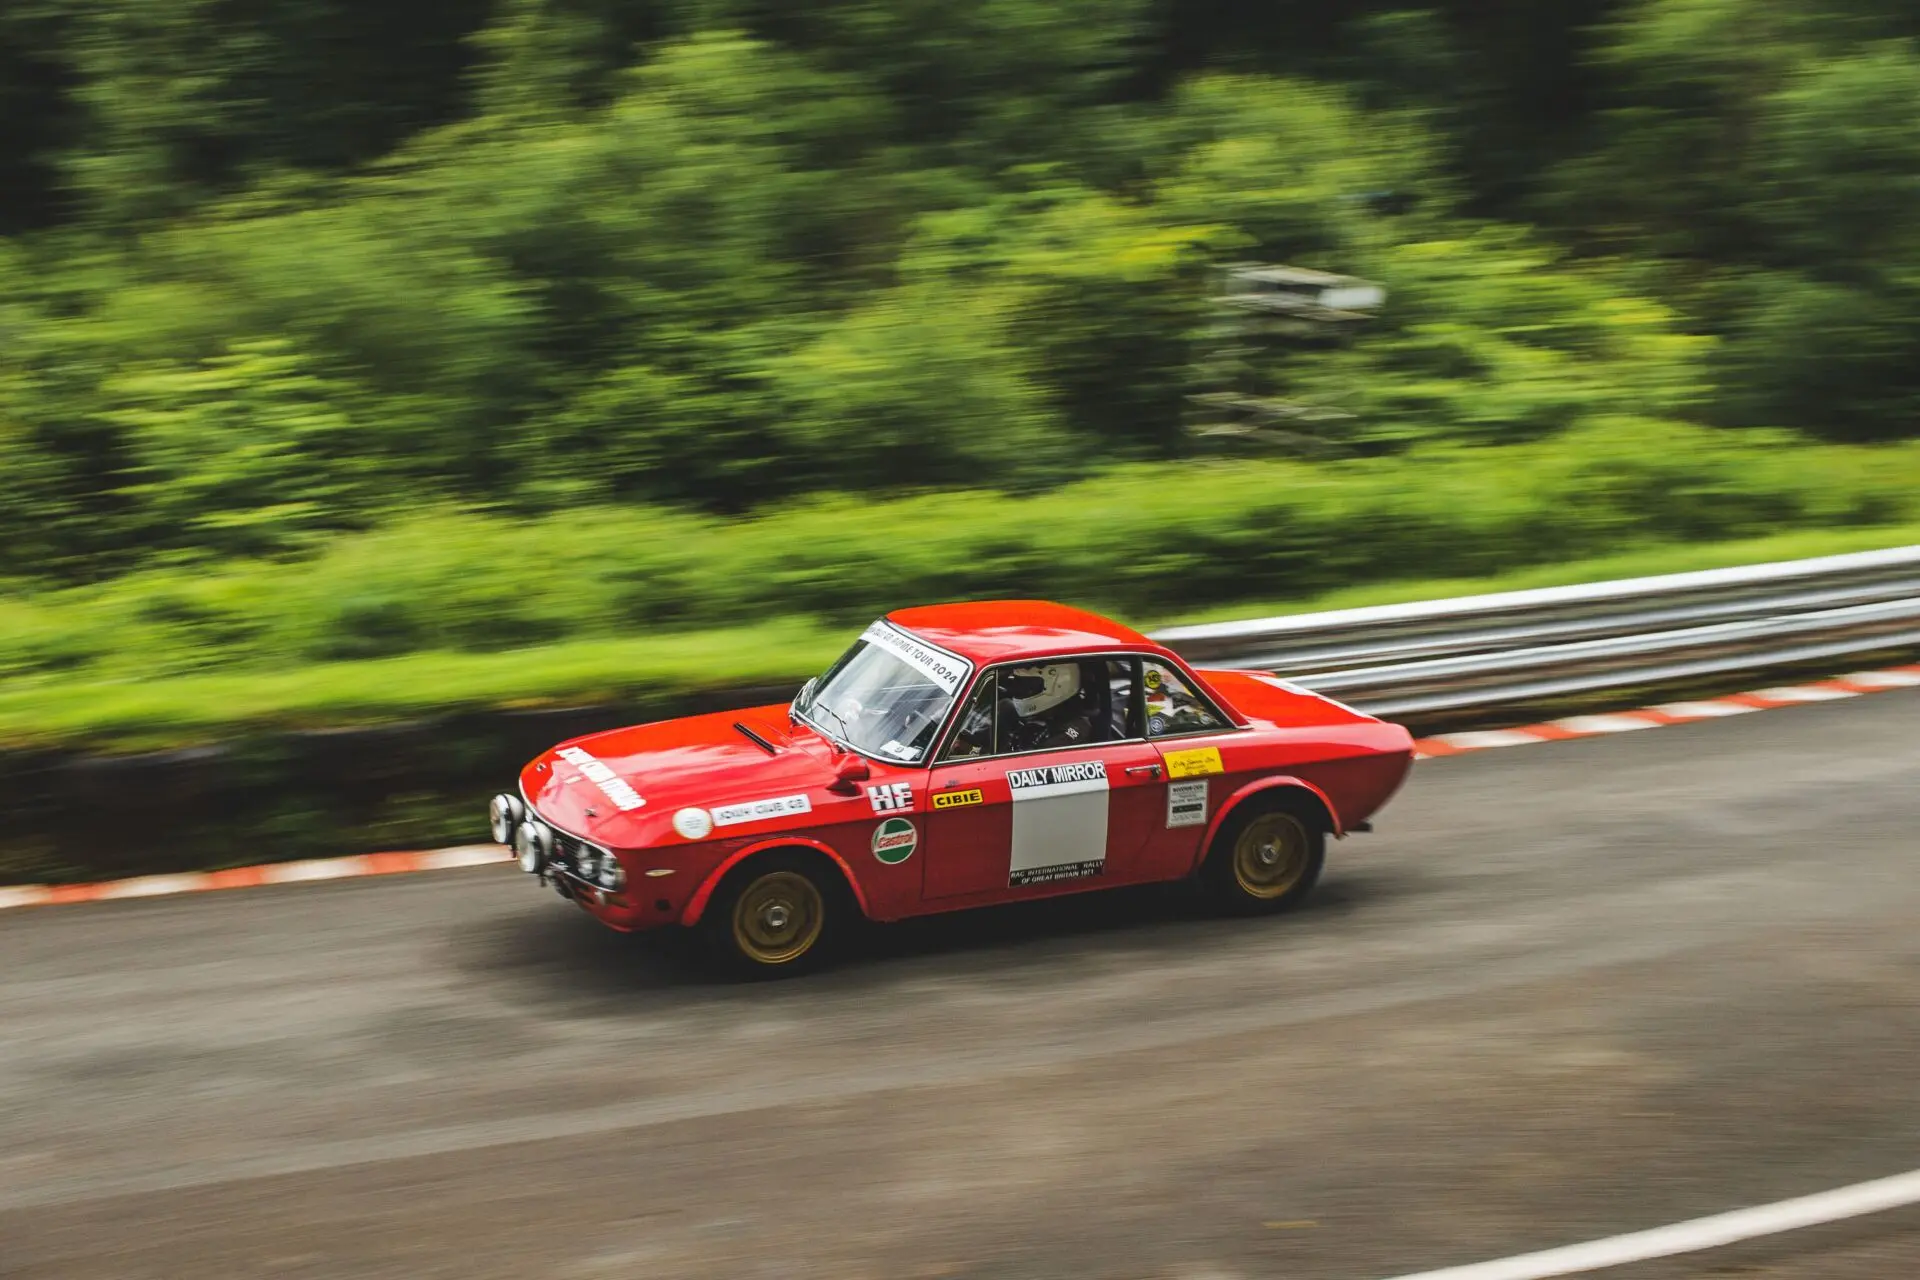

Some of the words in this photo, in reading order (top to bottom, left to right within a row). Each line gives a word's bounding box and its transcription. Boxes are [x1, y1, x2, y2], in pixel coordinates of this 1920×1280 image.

[911, 648, 934, 667] TOUR
[932, 662, 959, 684] 2024
[1009, 768, 1048, 789] DAILY
[1051, 762, 1106, 783] MIRROR
[867, 782, 914, 811] HF
[1010, 871, 1025, 879] RAC
[1027, 864, 1078, 876] INTERNATIONAL
[1083, 860, 1104, 869] RALLY
[1031, 874, 1053, 883] GREAT
[1054, 870, 1079, 880] BRITAIN
